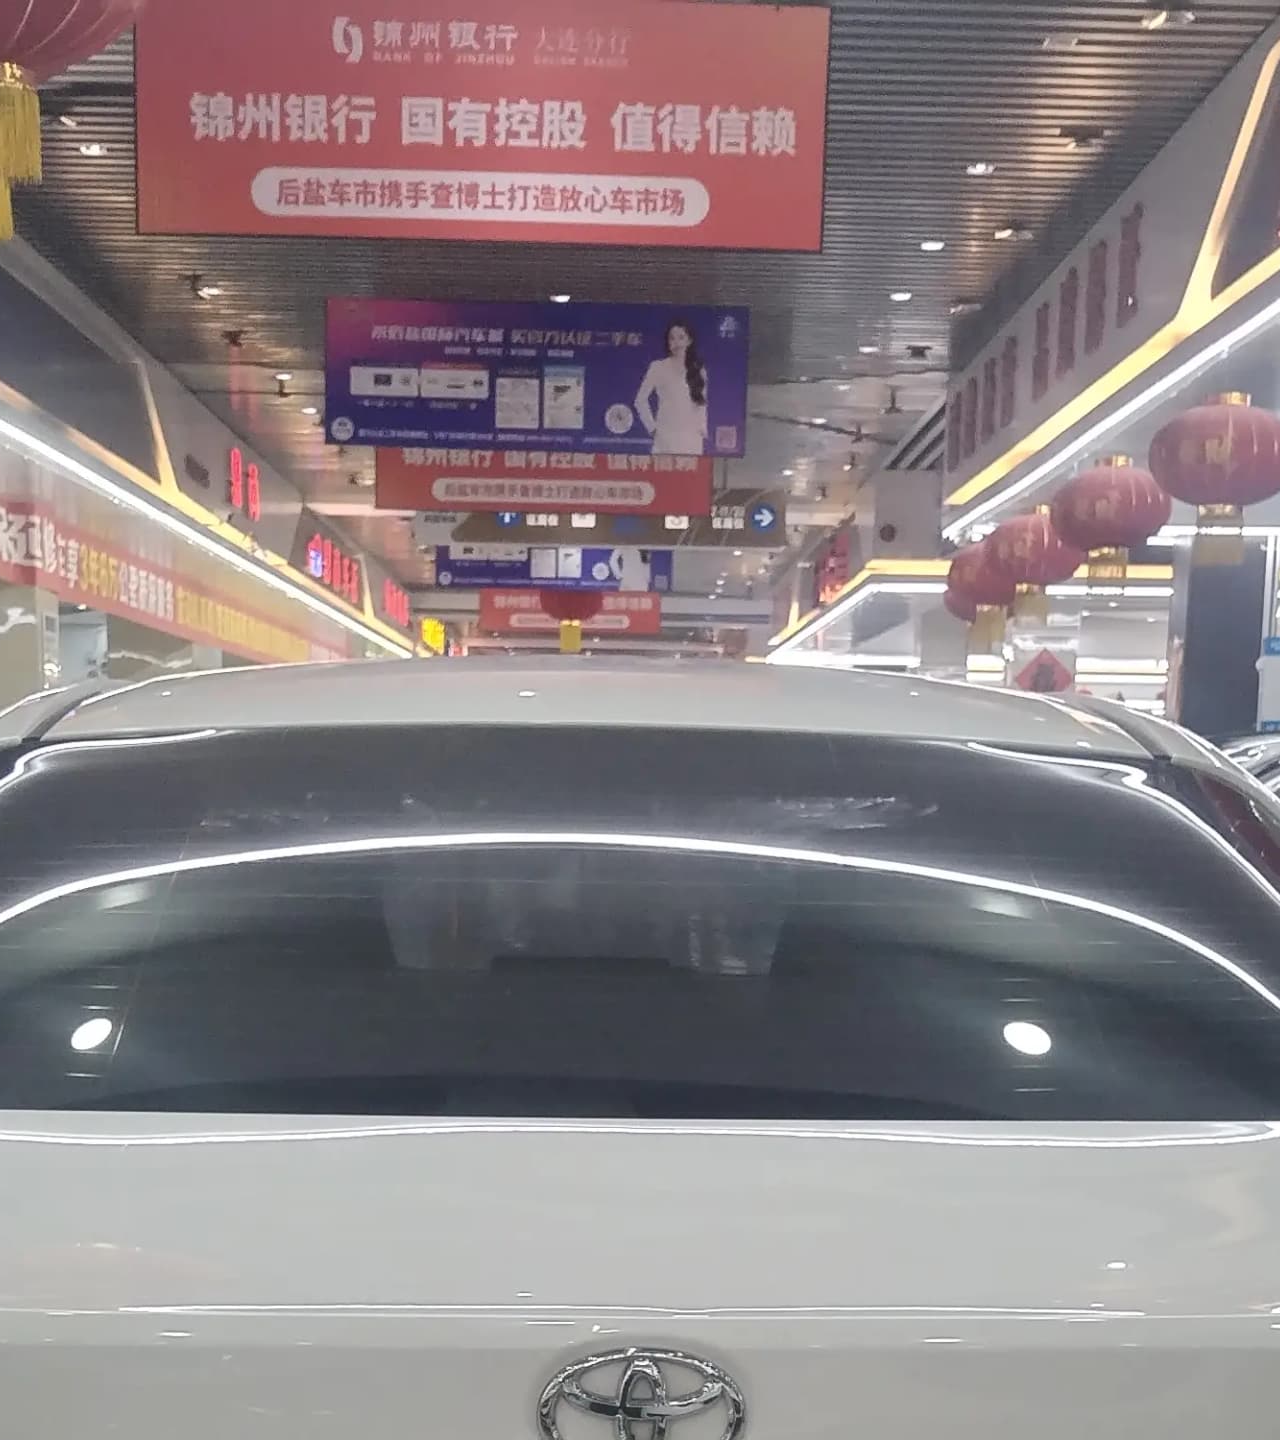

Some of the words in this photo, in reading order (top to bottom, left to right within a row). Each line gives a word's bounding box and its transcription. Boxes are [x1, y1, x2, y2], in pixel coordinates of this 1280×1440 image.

[190, 92, 376, 145] 锦州银行
[401, 96, 587, 151] 国有控股
[610, 100, 798, 157] 值得信赖
[276, 178, 686, 218] 后盐车市携手查博士打造放心车市场
